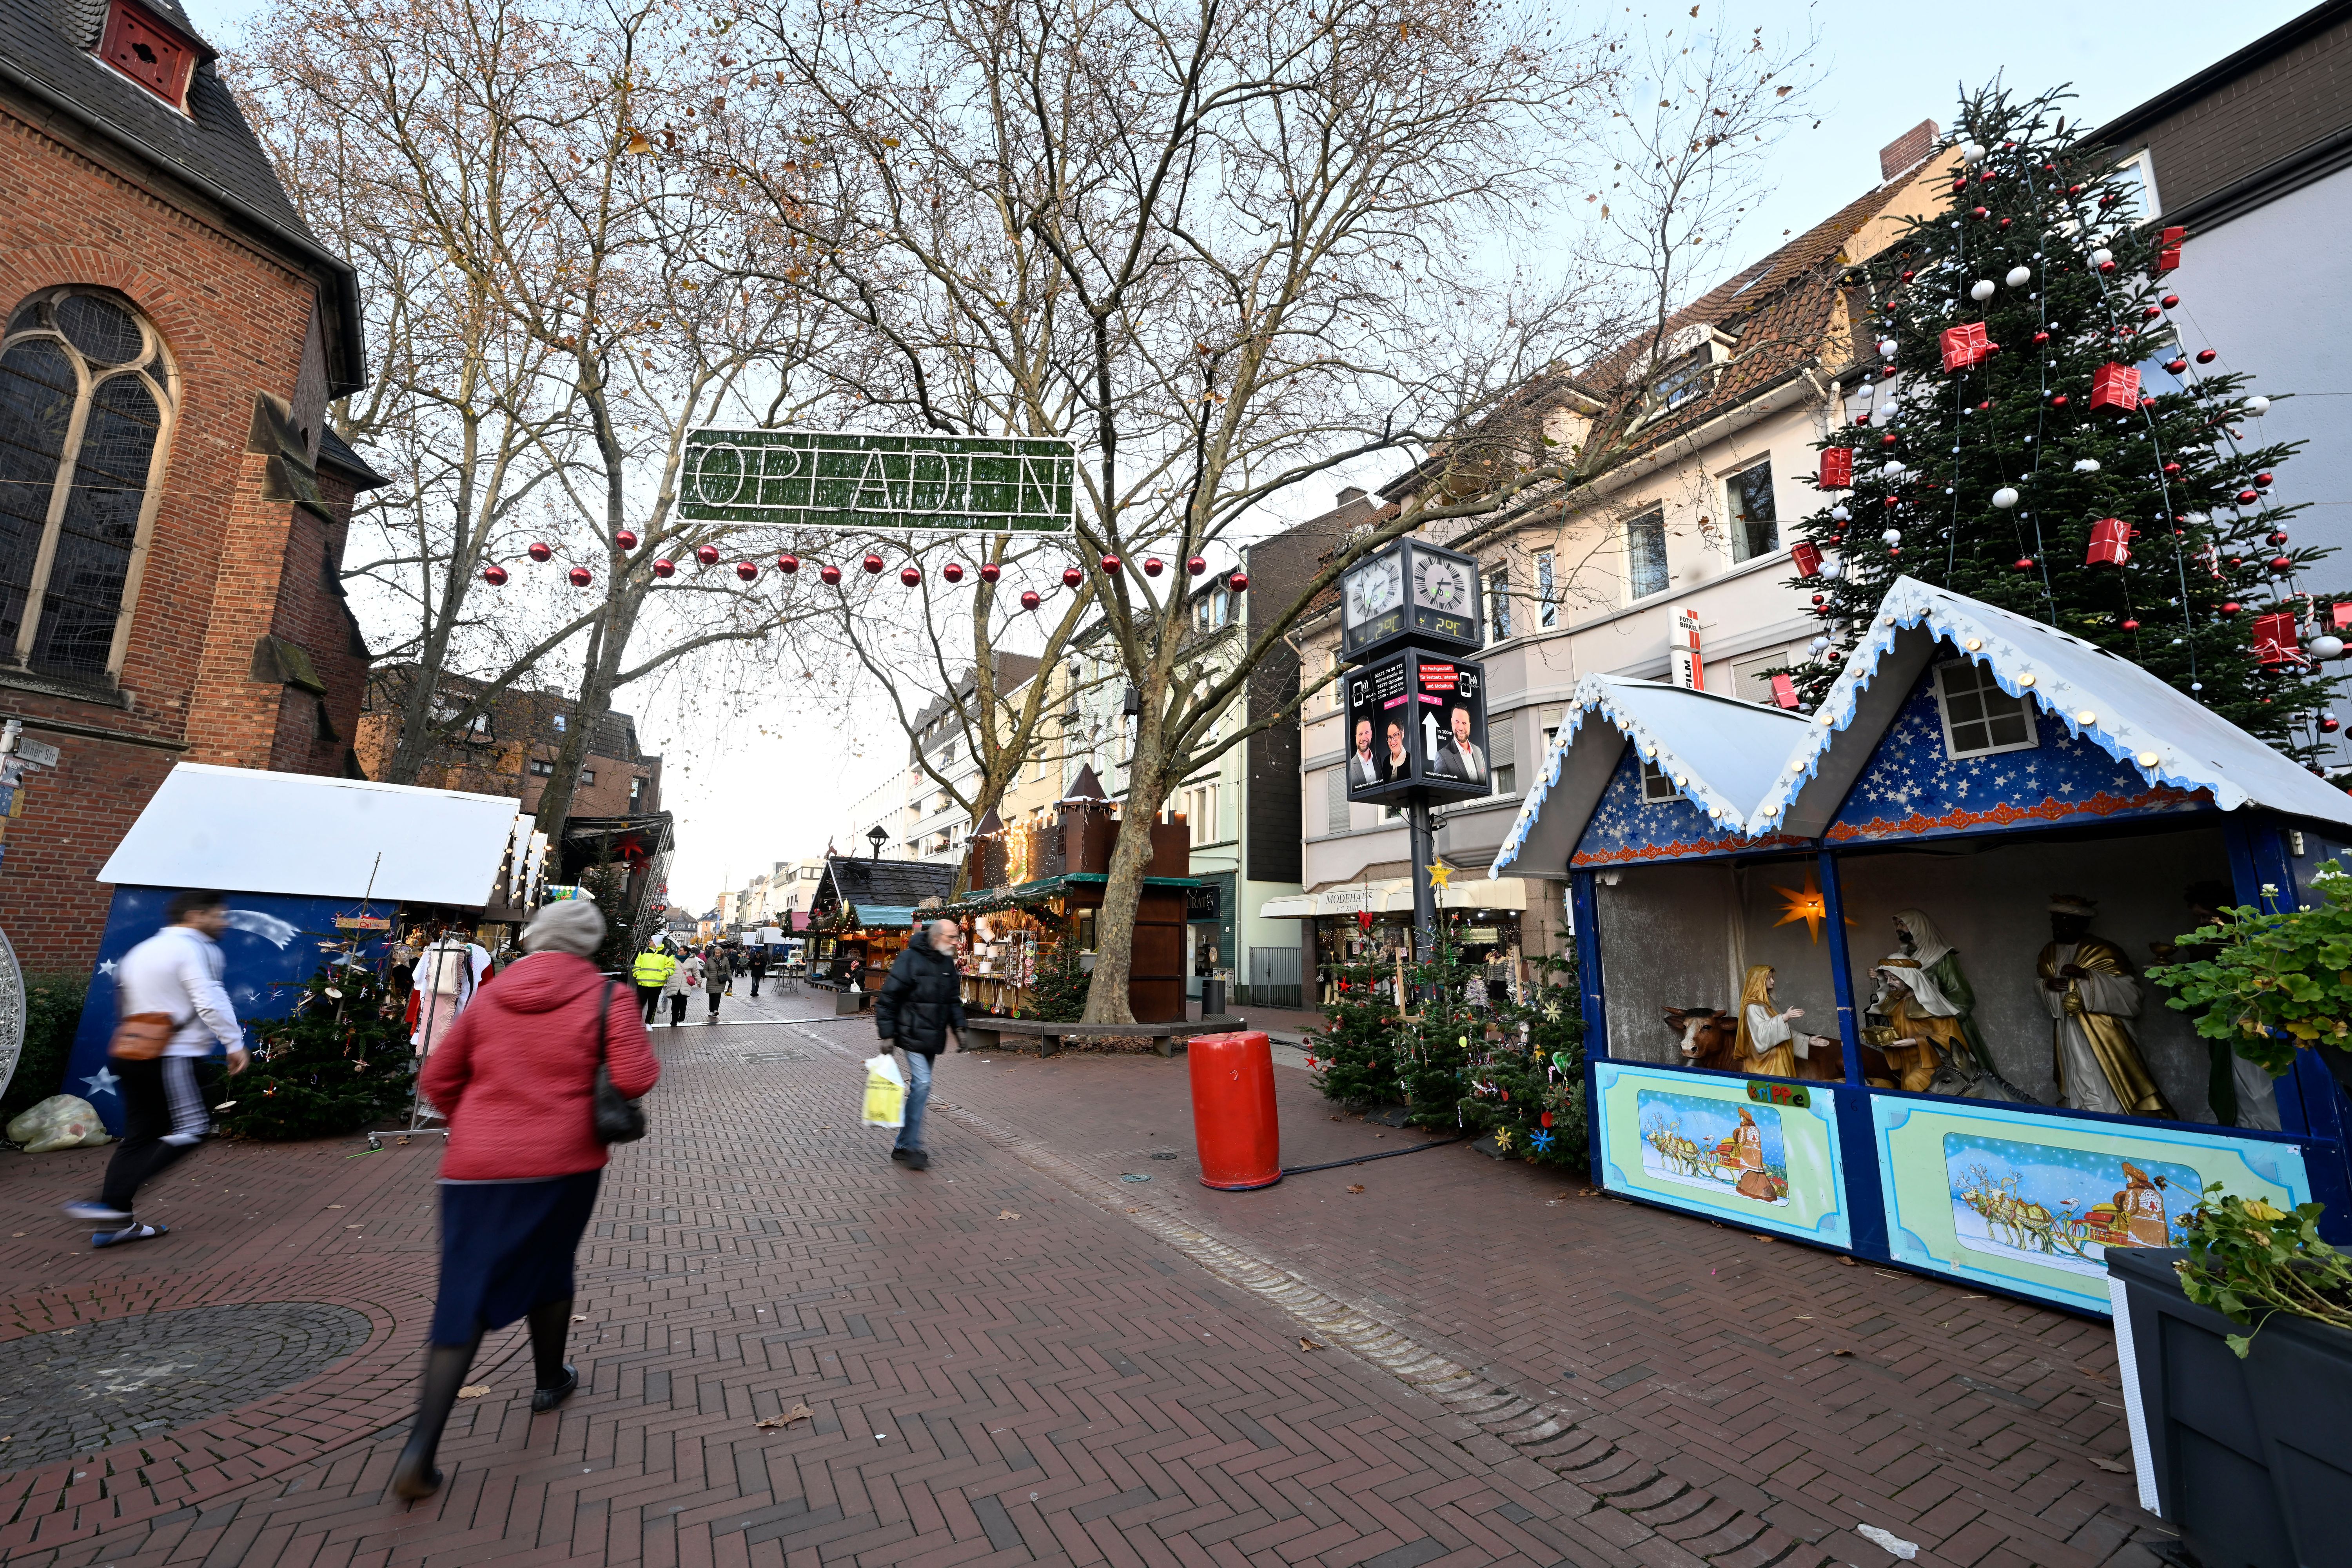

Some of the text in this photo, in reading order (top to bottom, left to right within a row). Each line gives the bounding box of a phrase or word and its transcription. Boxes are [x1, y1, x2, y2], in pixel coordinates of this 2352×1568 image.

[696, 442, 1058, 519] OPLADEN
[1679, 616, 1693, 624] FOTO
[1680, 622, 1698, 632] BIRKEL
[1376, 672, 1398, 684] Kölnerstraße
[1684, 660, 1693, 688] FILM
[1388, 676, 1403, 684] Opladen
[1359, 688, 1371, 696] opladen
[18, 740, 56, 762] Kölner Str.
[1425, 771, 1458, 779] handystore-opladen.de
[1355, 779, 1383, 789] handystore-opladen.de
[1748, 1083, 1804, 1106] krippe
[1851, 1099, 1858, 1111] 6
